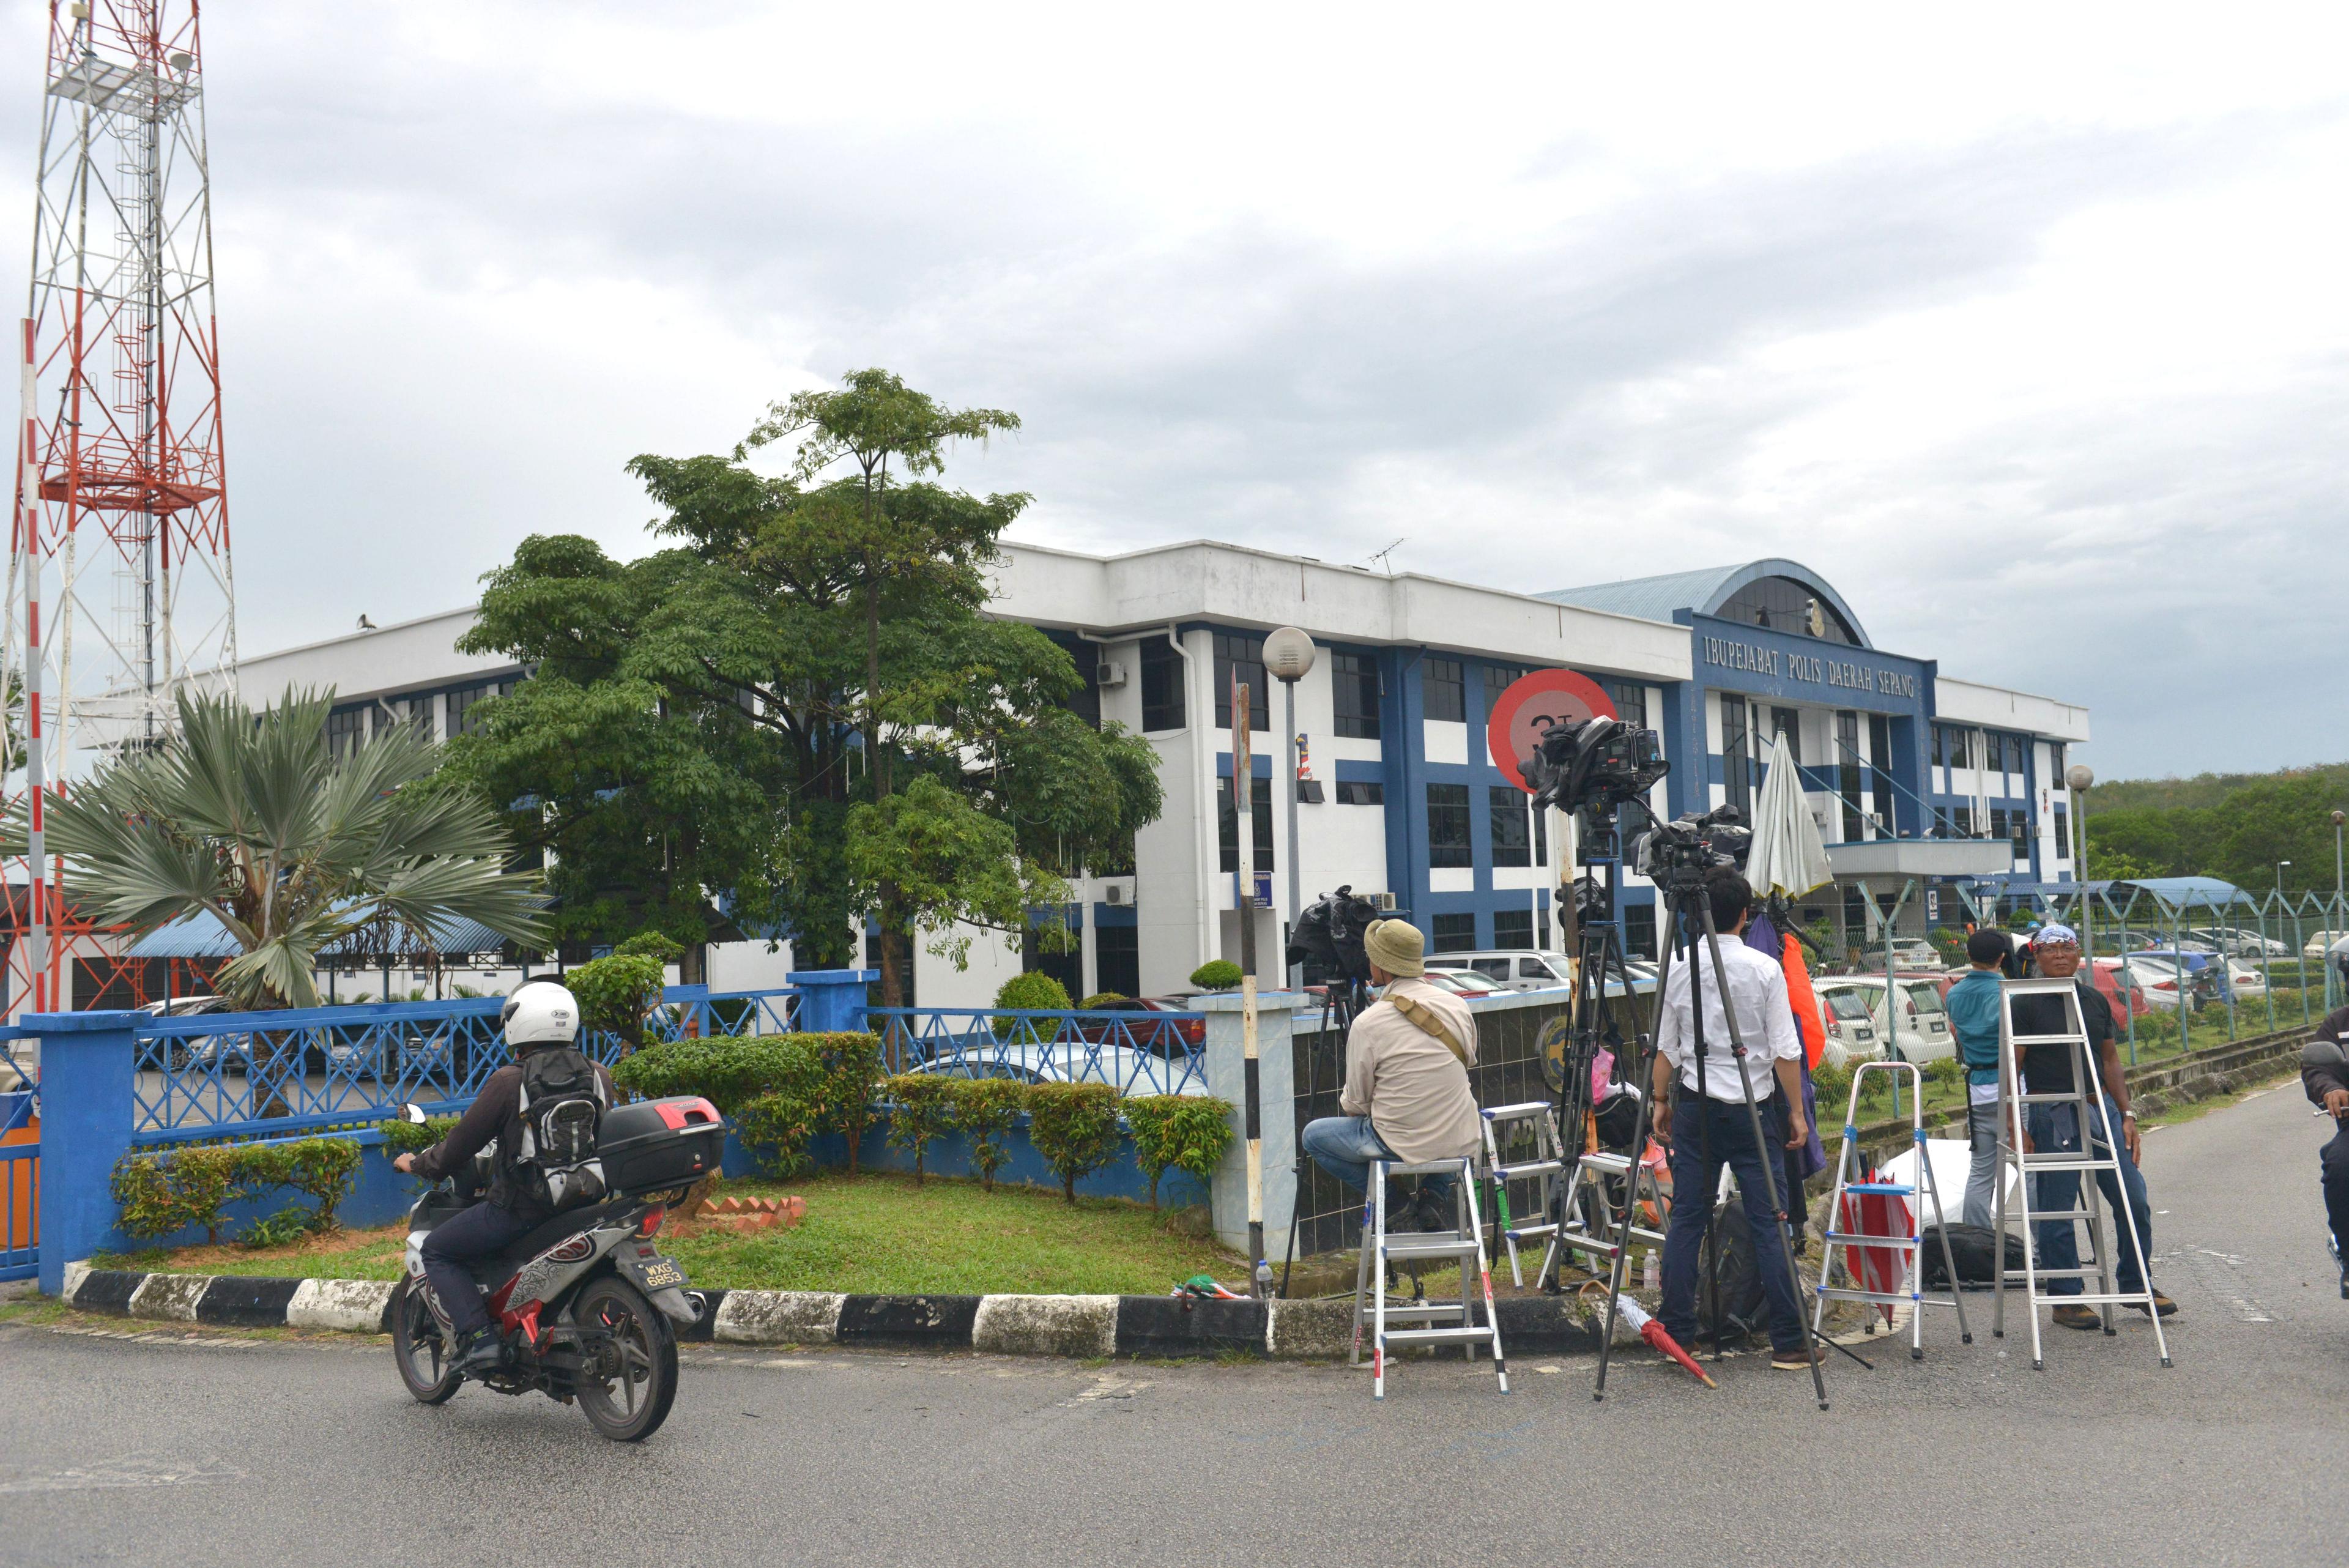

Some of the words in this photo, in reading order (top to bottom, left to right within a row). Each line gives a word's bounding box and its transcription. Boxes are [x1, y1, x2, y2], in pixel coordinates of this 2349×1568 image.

[1704, 636, 1778, 675] IBUPEJABAT
[1788, 654, 1820, 683] POLIS
[1828, 661, 1872, 690] DAERAH
[1879, 670, 1913, 697] SEPANG
[645, 1263, 672, 1276] WXG
[647, 1272, 682, 1287] 6853
